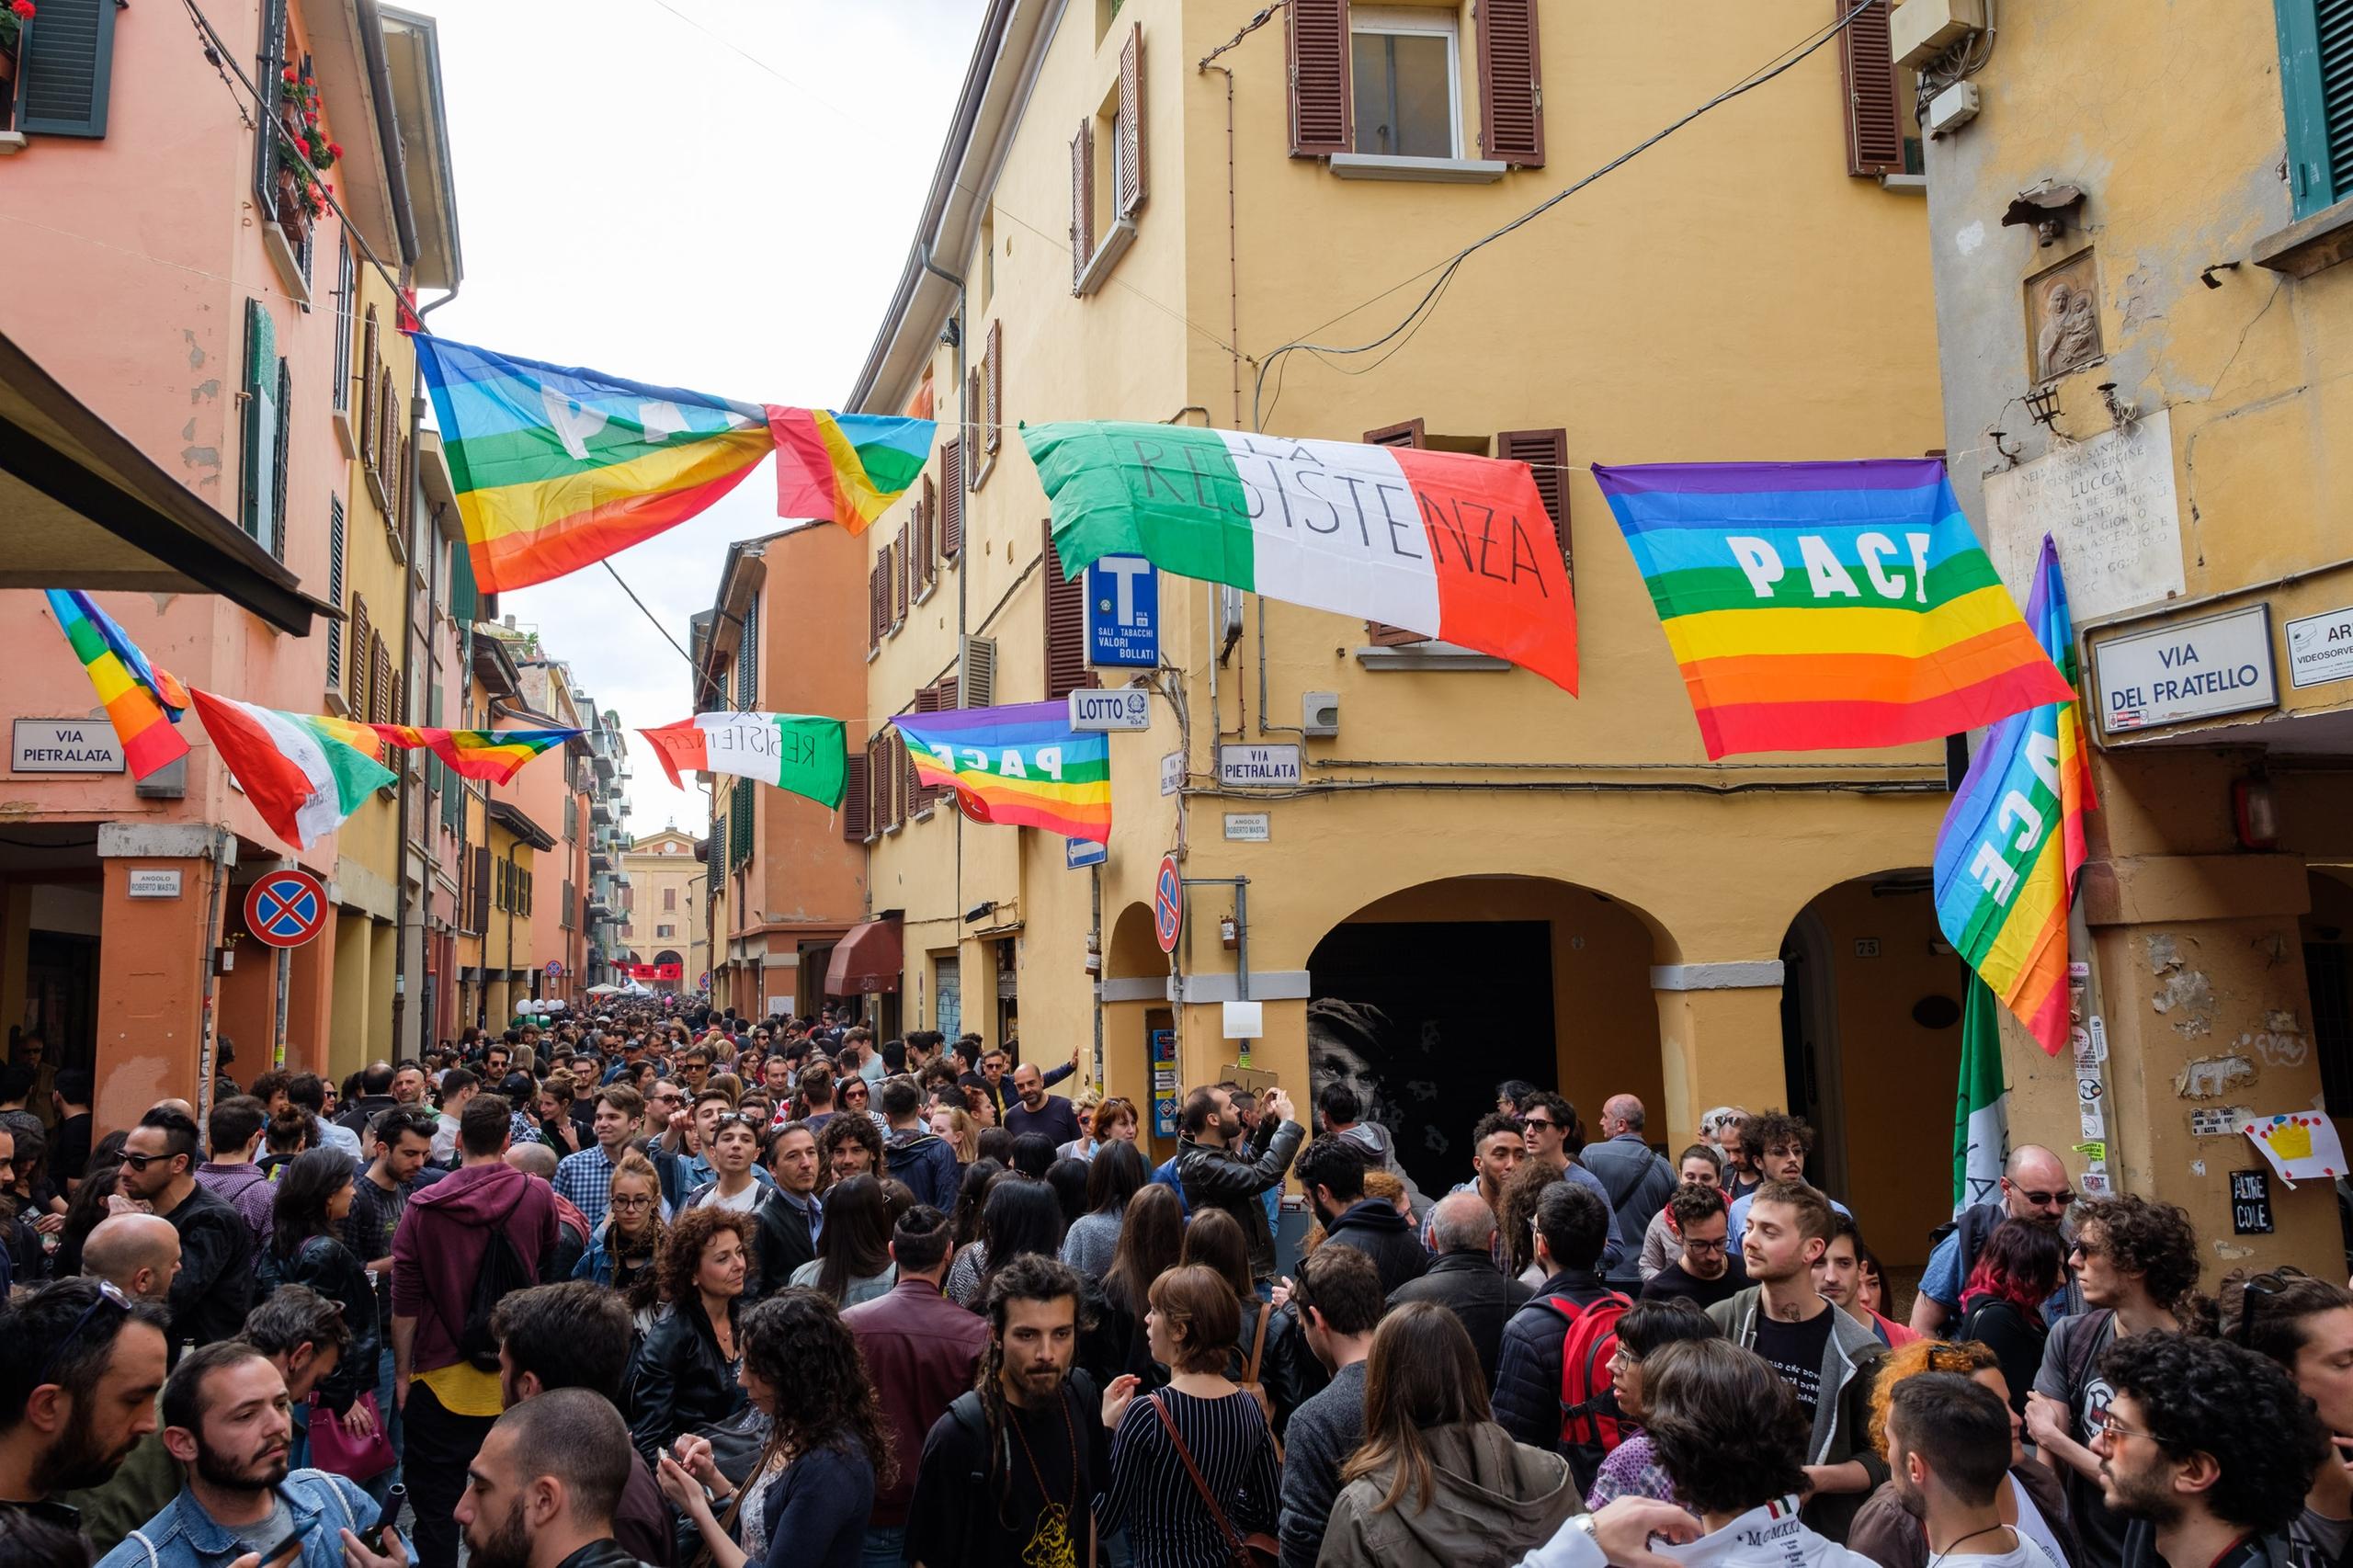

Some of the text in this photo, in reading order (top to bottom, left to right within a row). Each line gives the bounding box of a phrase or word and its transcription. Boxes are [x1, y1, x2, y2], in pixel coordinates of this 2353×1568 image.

[1245, 437, 1325, 467] LA
[2071, 469, 2123, 499] LUCCA
[1133, 439, 1548, 598] RESISTENZA
[2072, 504, 2113, 528] QUESTO
[1098, 556, 1150, 626] T
[1098, 627, 1153, 638] SALI TABACCHI
[1098, 637, 1128, 647] VALORI
[2327, 623, 2353, 642] AR
[1120, 648, 1154, 659] BOLLATI
[2158, 643, 2200, 669] VIA
[2111, 665, 2258, 710] DEL PRATELLO
[1078, 698, 1123, 720] LOTTO
[56, 731, 84, 743] VIA
[24, 749, 112, 762] PIETRALATA
[1251, 750, 1268, 762] VIA
[1225, 764, 1296, 778] PIETRALATA
[131, 883, 177, 892] ROBERTO MASTAI
